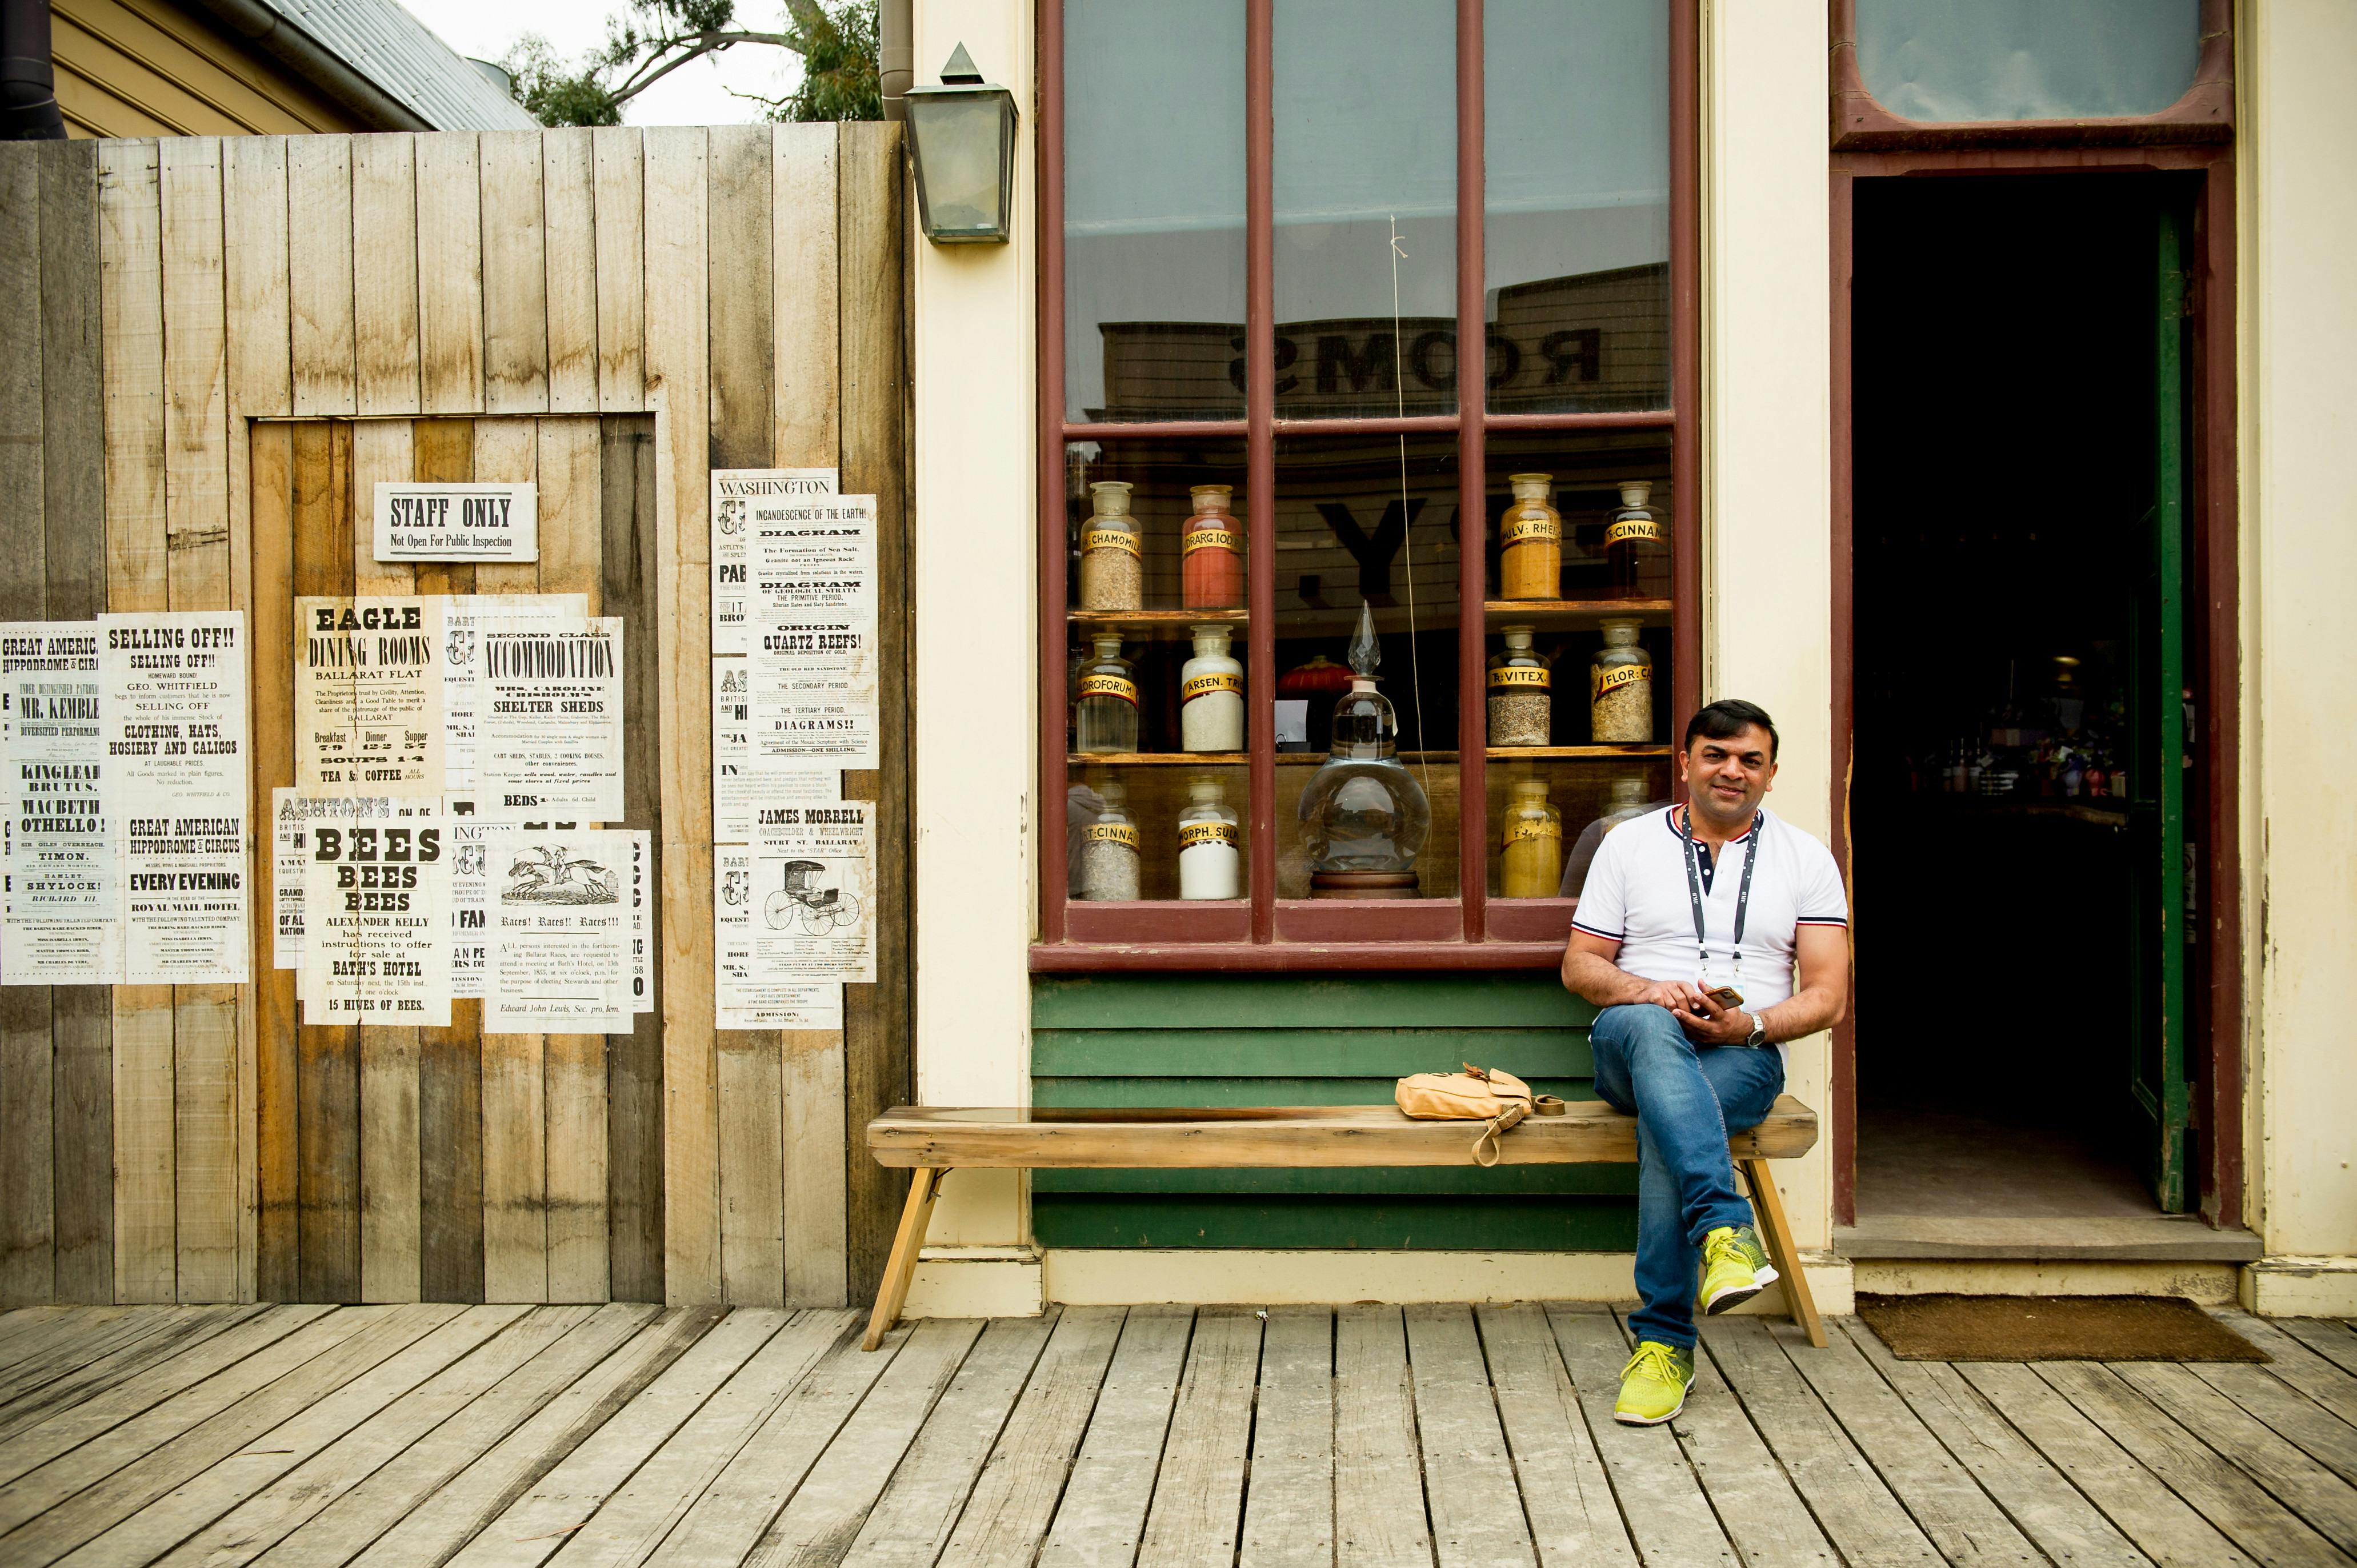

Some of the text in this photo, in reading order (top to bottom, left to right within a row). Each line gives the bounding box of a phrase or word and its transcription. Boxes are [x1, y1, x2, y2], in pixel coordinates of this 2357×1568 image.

[719, 480, 830, 495] WASHINGTON
[391, 498, 511, 527] STAFF ONLY
[757, 508, 866, 520] INCANDESCENCE OF THE EARTH!
[391, 534, 512, 548] Not Open For Public Inspection
[1092, 534, 1140, 552] CHAMOMILE
[317, 607, 421, 631] EAGLE
[109, 628, 234, 649] SELLING OFF!!
[764, 634, 861, 649] QUARTZ REEFS!
[3, 637, 98, 656] GREAT AMERIC
[309, 636, 430, 667] DINING ROOMS
[3, 659, 69, 671] HIPPODROME
[130, 654, 215, 668] SELLING OFF!!
[485, 640, 614, 678] ACCOMMODATION
[316, 671, 384, 680] BALLARAT
[1606, 670, 1639, 685] FLOR:
[1188, 677, 1223, 693] ARSEN.
[21, 697, 43, 719] MR.
[49, 697, 99, 719] KEMBLE
[494, 701, 604, 712] SHELTER SHEDS
[21, 727, 58, 736] DIVERSIFIED
[125, 724, 222, 740] CLOTHING, HATS,
[775, 720, 854, 730] DIAGRAMS!!
[315, 731, 428, 743] Breakfast Dinner Supper
[109, 740, 237, 755] HOSIERY AND CALICOS
[321, 769, 402, 782] TEA & COFFEE
[29, 783, 97, 792] BRUTUS.
[22, 800, 100, 814] MACBETH
[503, 795, 538, 806] BEDS
[279, 797, 390, 820] ASHTON'S
[758, 809, 864, 824] JAMES MORRELL
[130, 819, 239, 836] GREAT AMERICAN
[759, 828, 804, 836] COACHBUILDER
[130, 839, 239, 854] HIPPODROME & CIRCUS
[315, 828, 440, 861] BEES
[130, 873, 240, 891] EVERY EVENING
[338, 866, 417, 888] BEES
[345, 893, 410, 911] BEES
[326, 917, 429, 927] ALEXANDER KELLY
[501, 916, 618, 927] Races! Races!! Races!!!
[333, 961, 422, 976] BATH'S HOTEL
[329, 1000, 425, 1010] 15 HIVES OF BEES.
[501, 1004, 587, 1013] Edward John Lewis, Sec.
